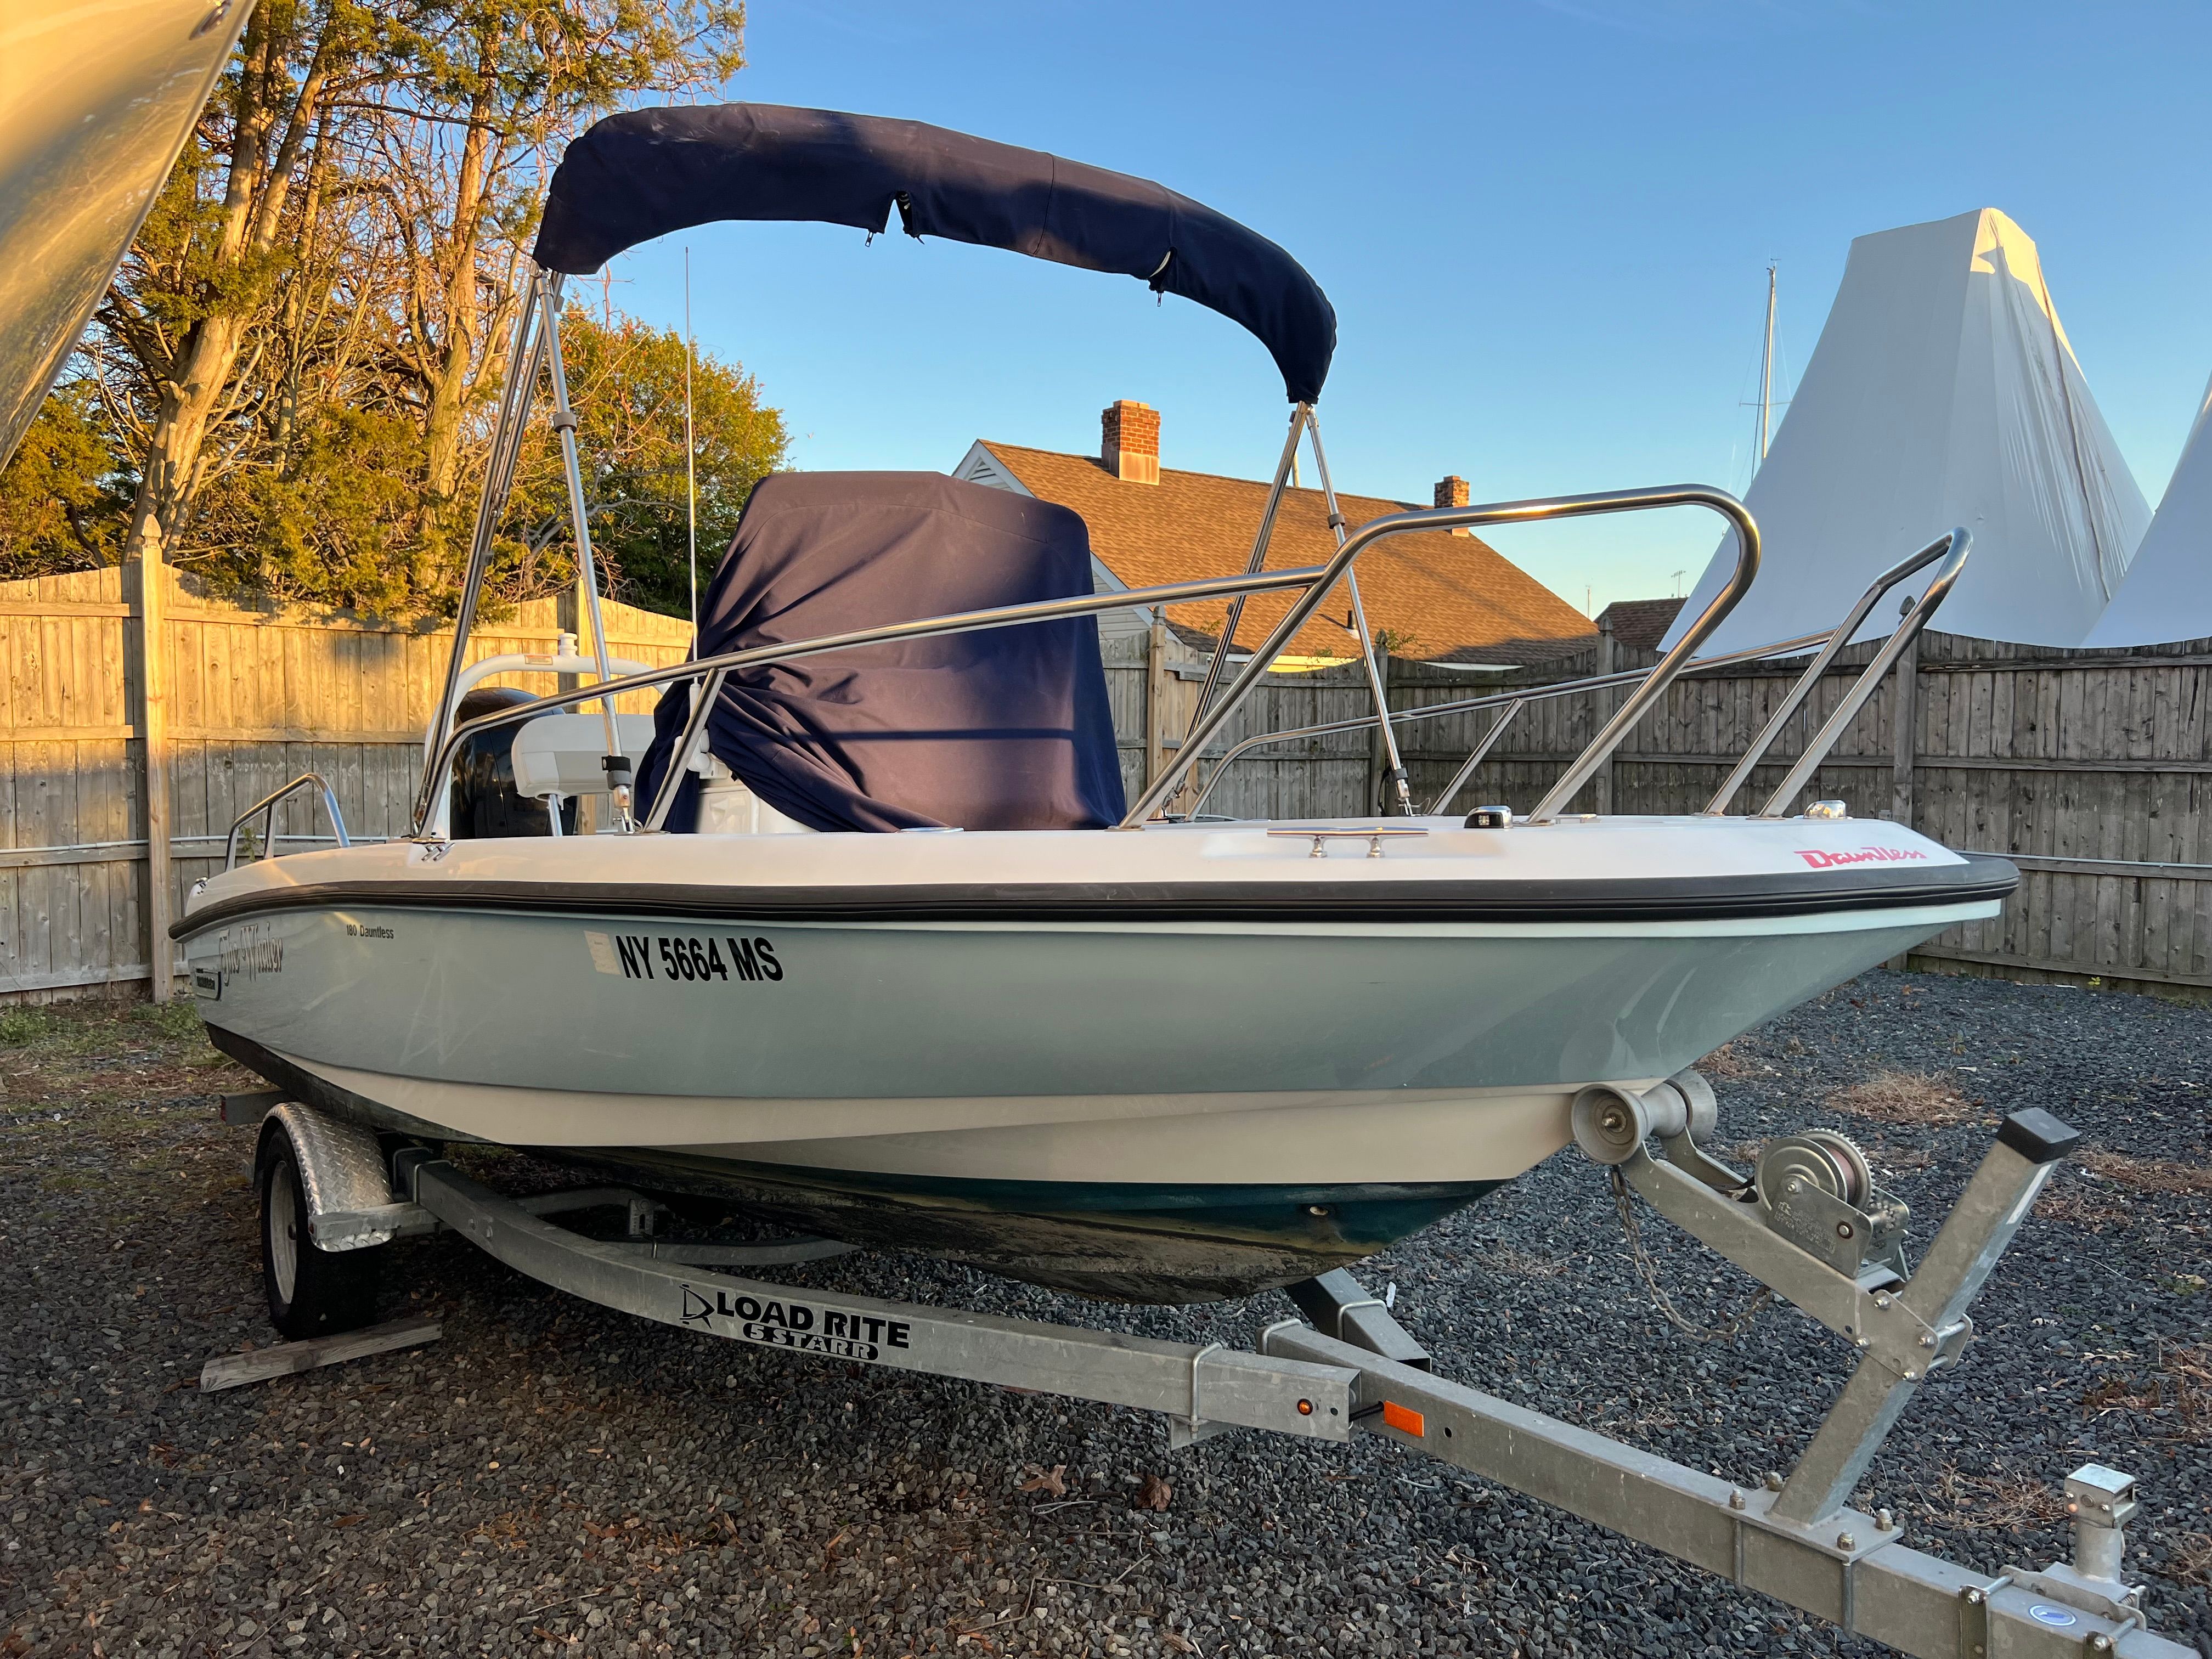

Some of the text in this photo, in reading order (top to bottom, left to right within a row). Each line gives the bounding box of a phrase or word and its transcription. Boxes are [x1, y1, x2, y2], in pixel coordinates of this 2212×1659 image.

[1793, 847, 1927, 868] Dauntless
[346, 924, 394, 939] 180 Dauntless
[616, 935, 783, 981] NY 5664 MS
[716, 1291, 910, 1349] LOAD RITE
[750, 1325, 871, 1359] 5 STARR
